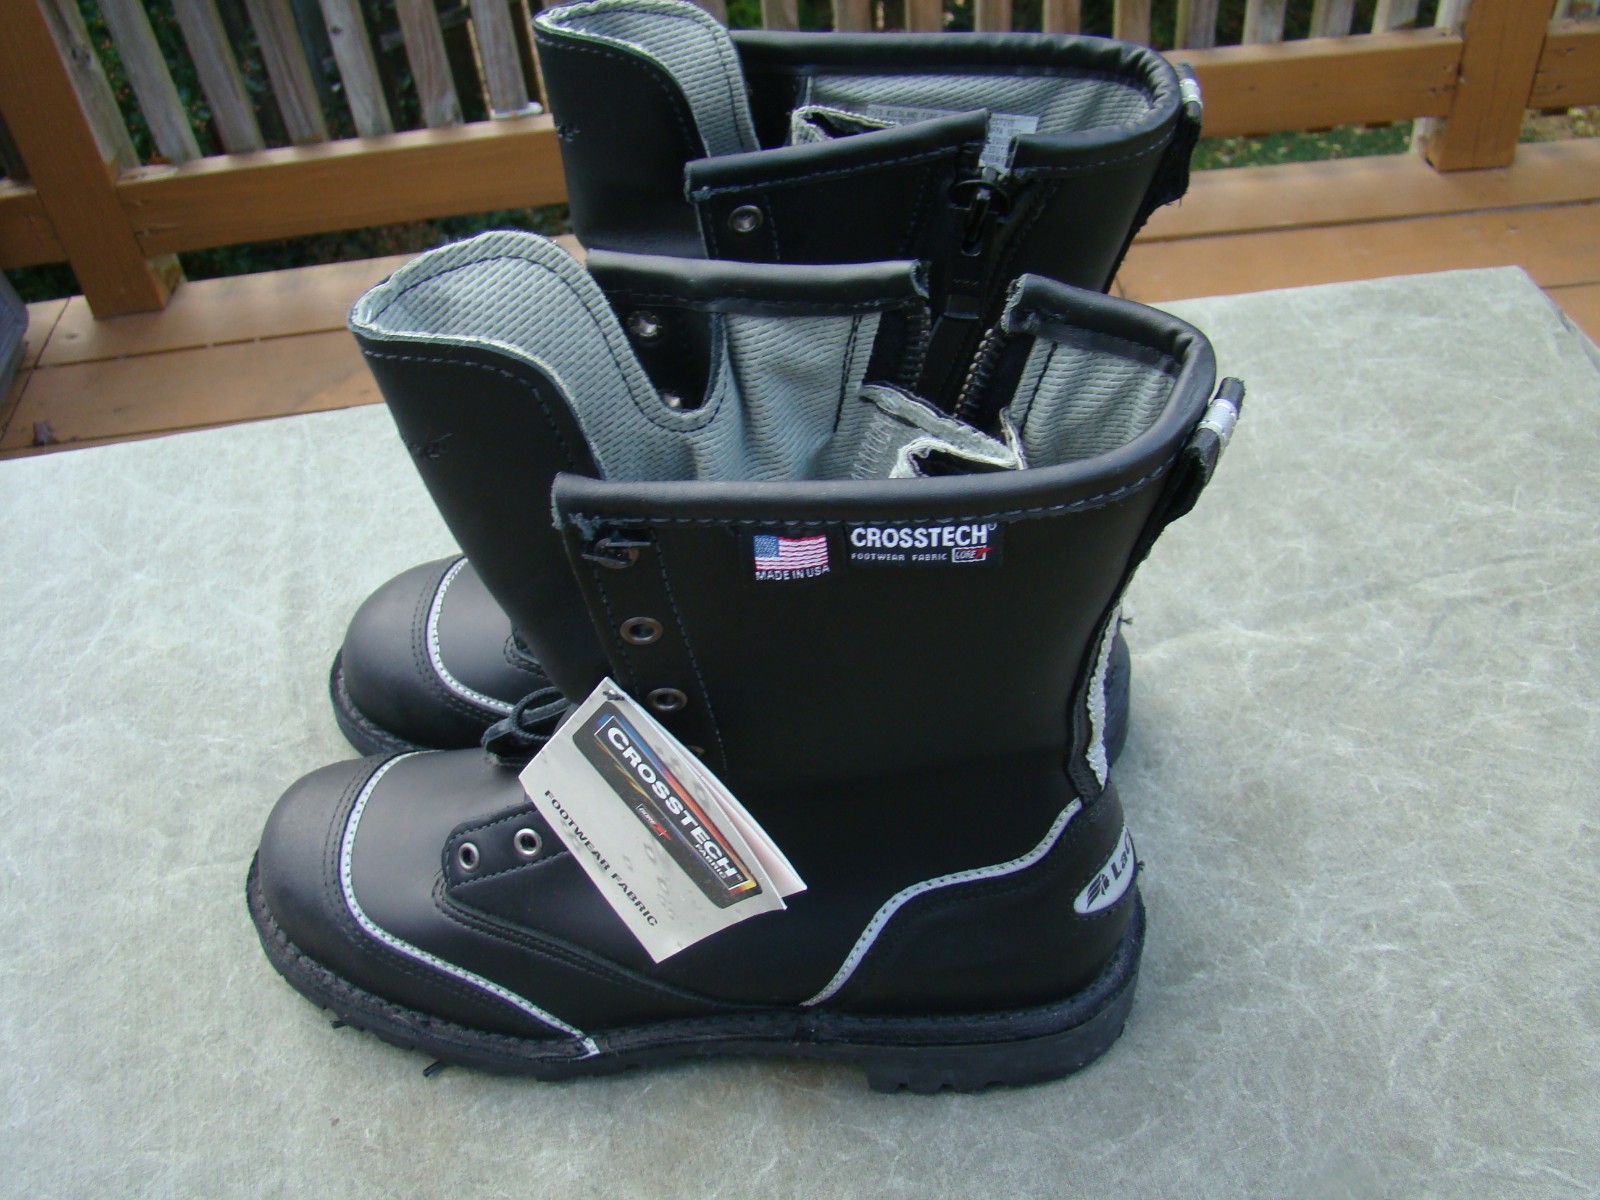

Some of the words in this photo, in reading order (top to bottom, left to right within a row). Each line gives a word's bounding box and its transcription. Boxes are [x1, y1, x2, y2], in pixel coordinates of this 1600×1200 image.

[850, 524, 988, 548] CROSSTECH
[850, 552, 905, 562] FOOTWEAR
[911, 552, 948, 562] FABRIC
[755, 570, 790, 581] MADE
[792, 570, 805, 580] IN
[807, 565, 830, 579] USA
[607, 726, 738, 880] CROSSTECH
[544, 789, 611, 873] FOOTWEAR
[612, 872, 658, 928] FABRIC
[695, 843, 727, 879] FABRIC
